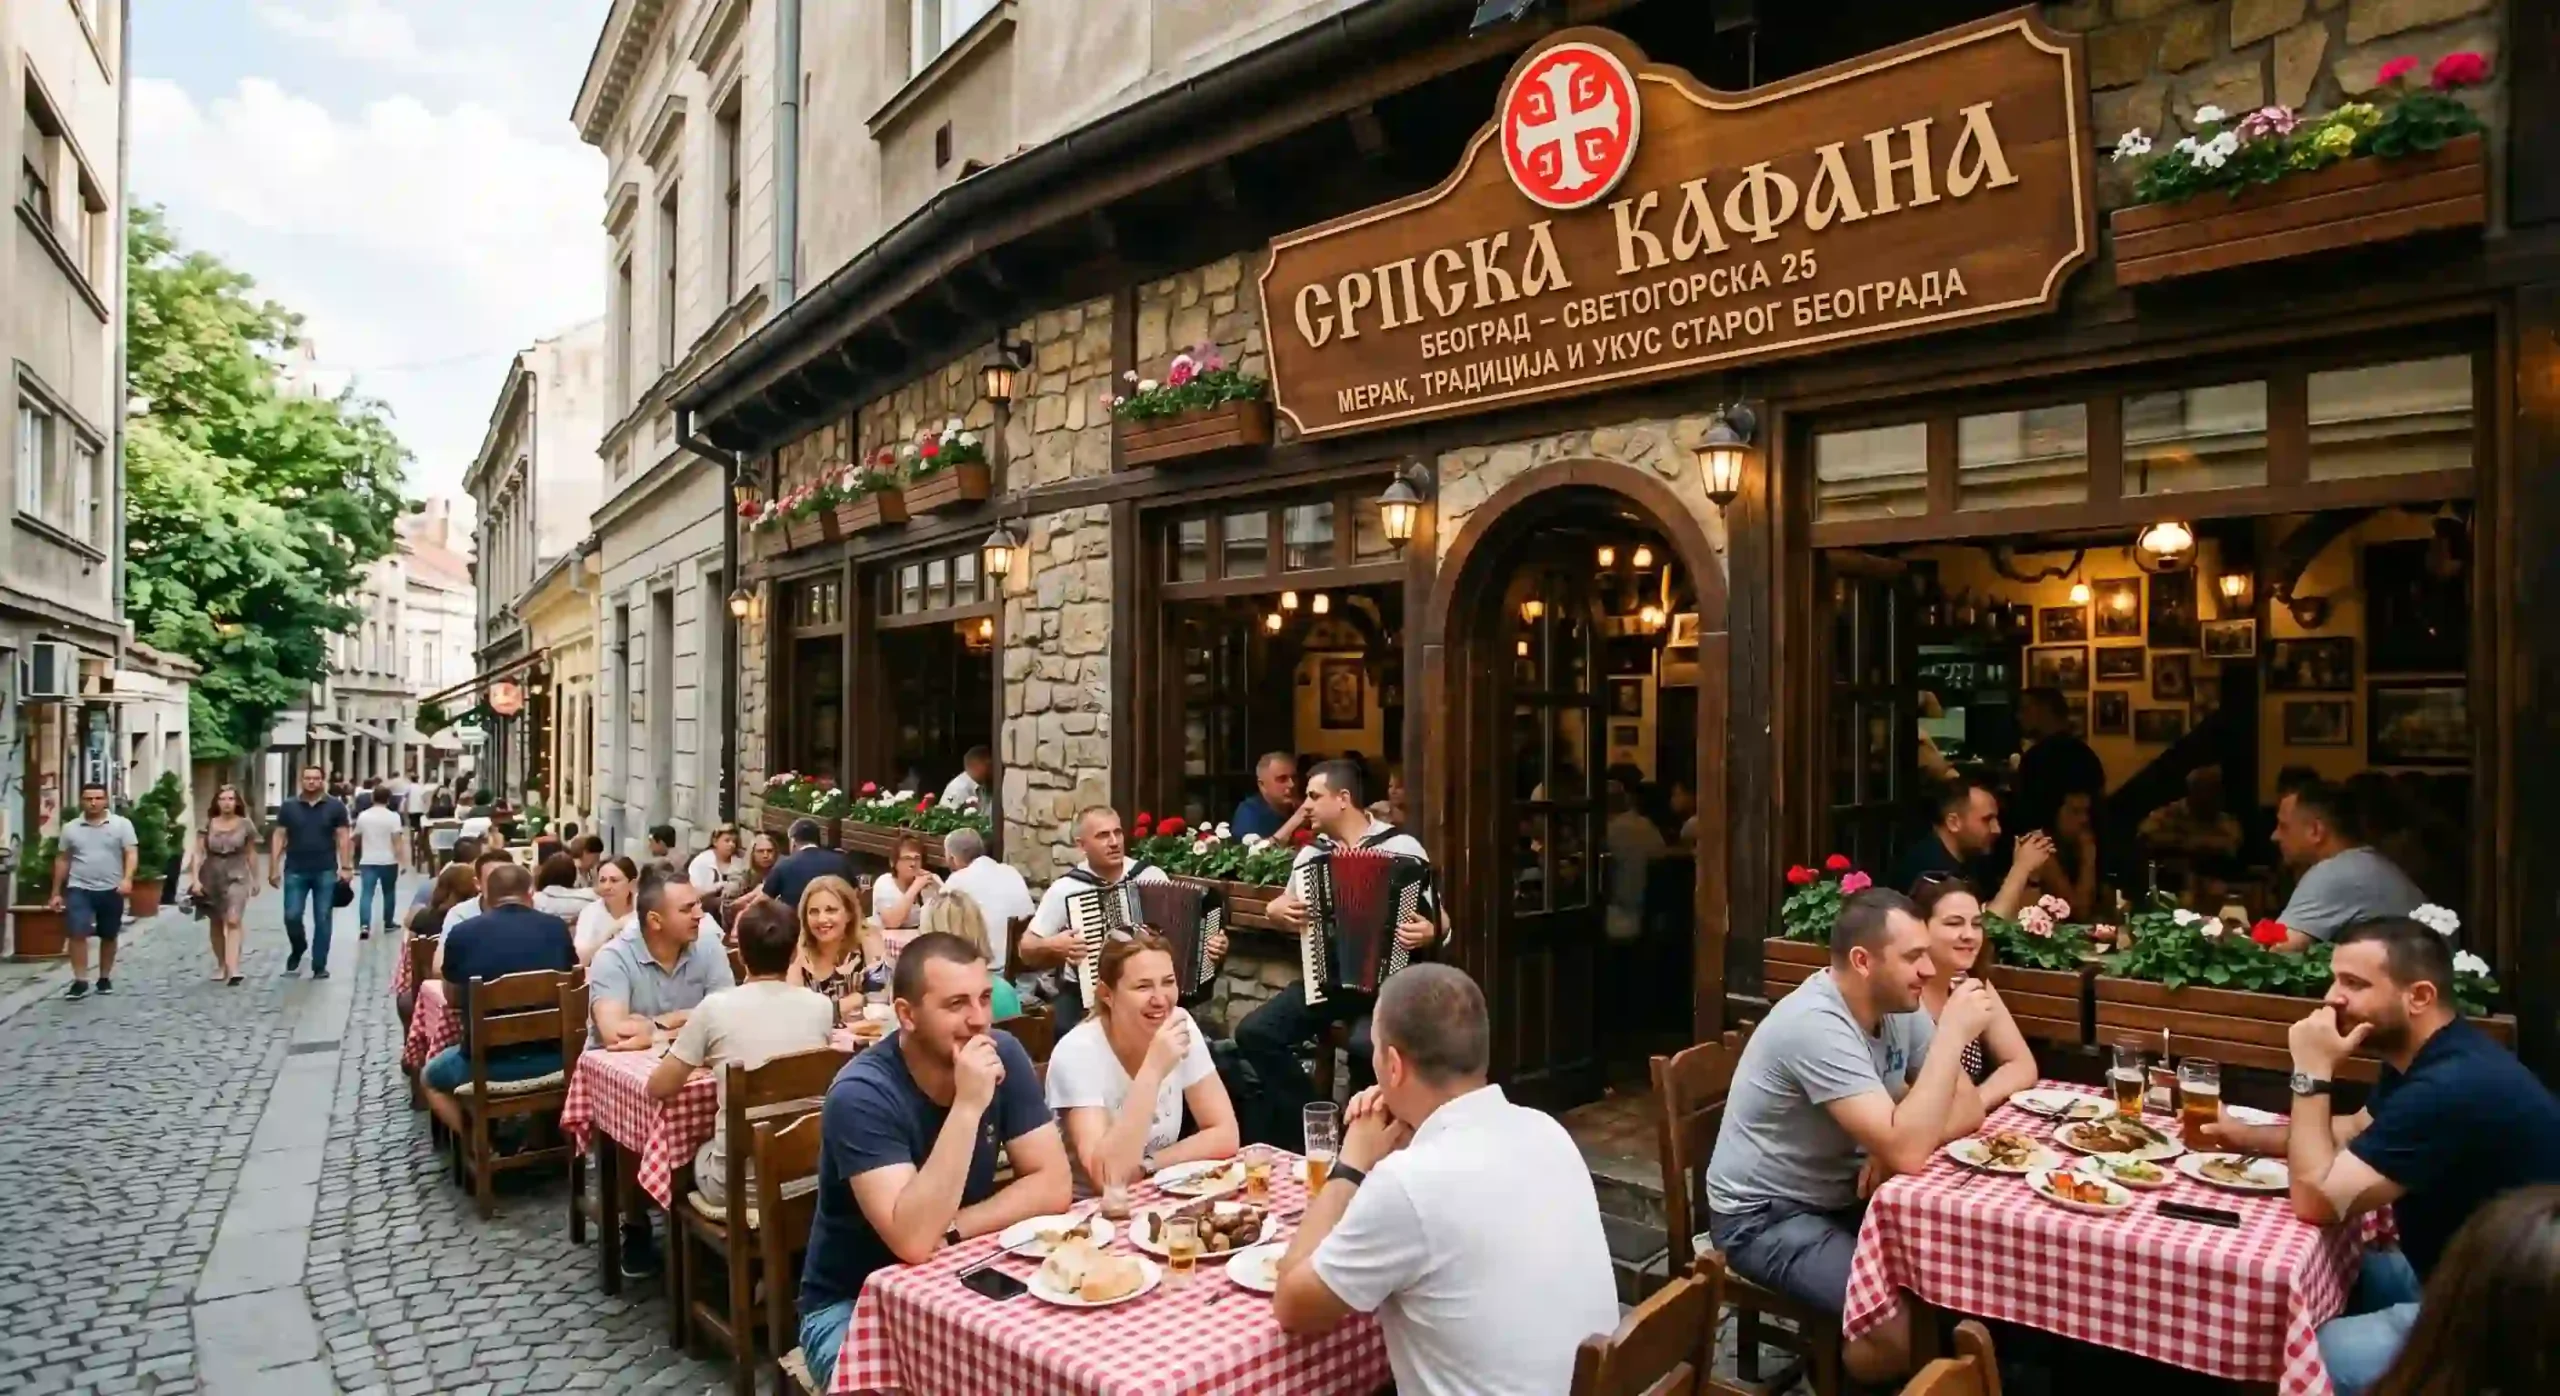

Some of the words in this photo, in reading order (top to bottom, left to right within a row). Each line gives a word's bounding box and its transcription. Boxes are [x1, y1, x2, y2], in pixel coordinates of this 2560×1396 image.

[1295, 220, 1573, 348] СРПСКА
[1608, 101, 2019, 275] КАФАНА
[1337, 377, 1415, 414] МЕРАК,
[1420, 348, 1561, 397] ТРАДИЦИЈА
[1567, 343, 1586, 370] И
[1592, 327, 1662, 365] УКУС
[1671, 301, 1782, 350] СТАРОГ
[1793, 267, 1969, 327] БЕОГРАДА
[1420, 312, 1532, 359] БЕОГРАД
[1563, 260, 1771, 328] СВЕТОГОРСКА
[1781, 249, 1818, 284] 25
